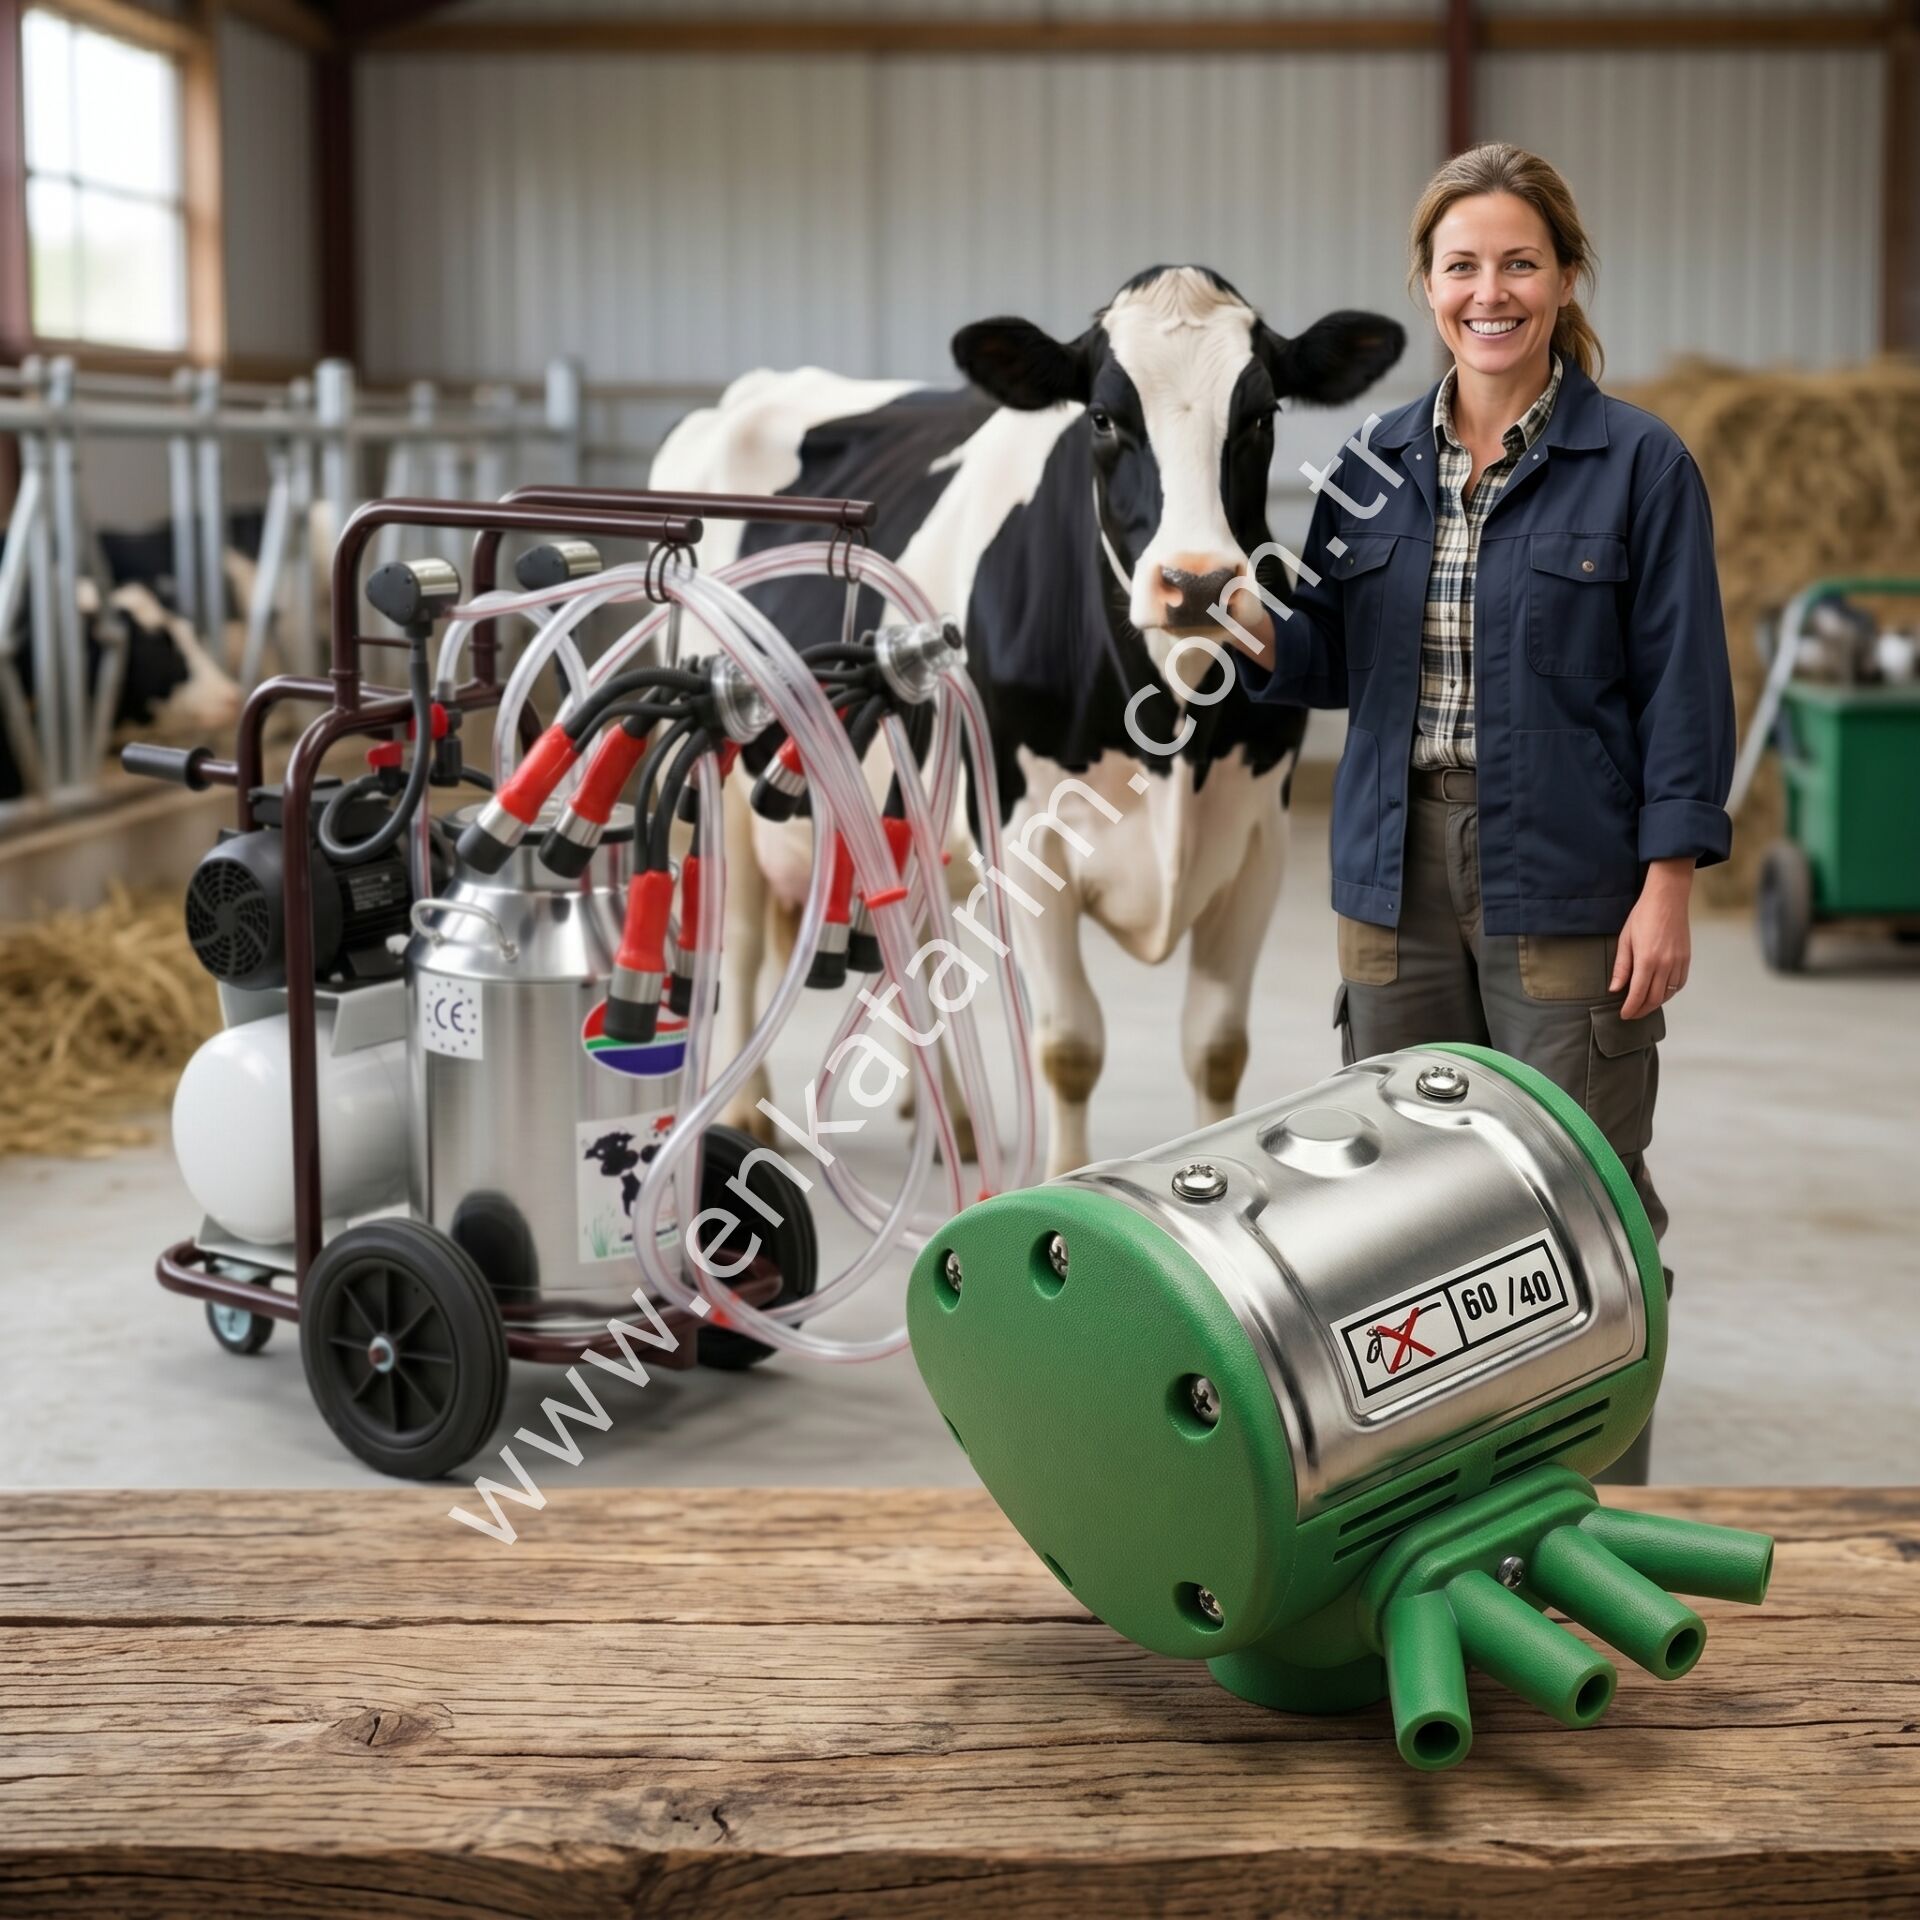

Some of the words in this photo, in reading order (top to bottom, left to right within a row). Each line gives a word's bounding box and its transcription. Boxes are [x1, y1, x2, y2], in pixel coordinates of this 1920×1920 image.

[434, 998, 464, 1033] CE
[1461, 1282, 1498, 1321] 60
[1507, 1270, 1552, 1317] /40
